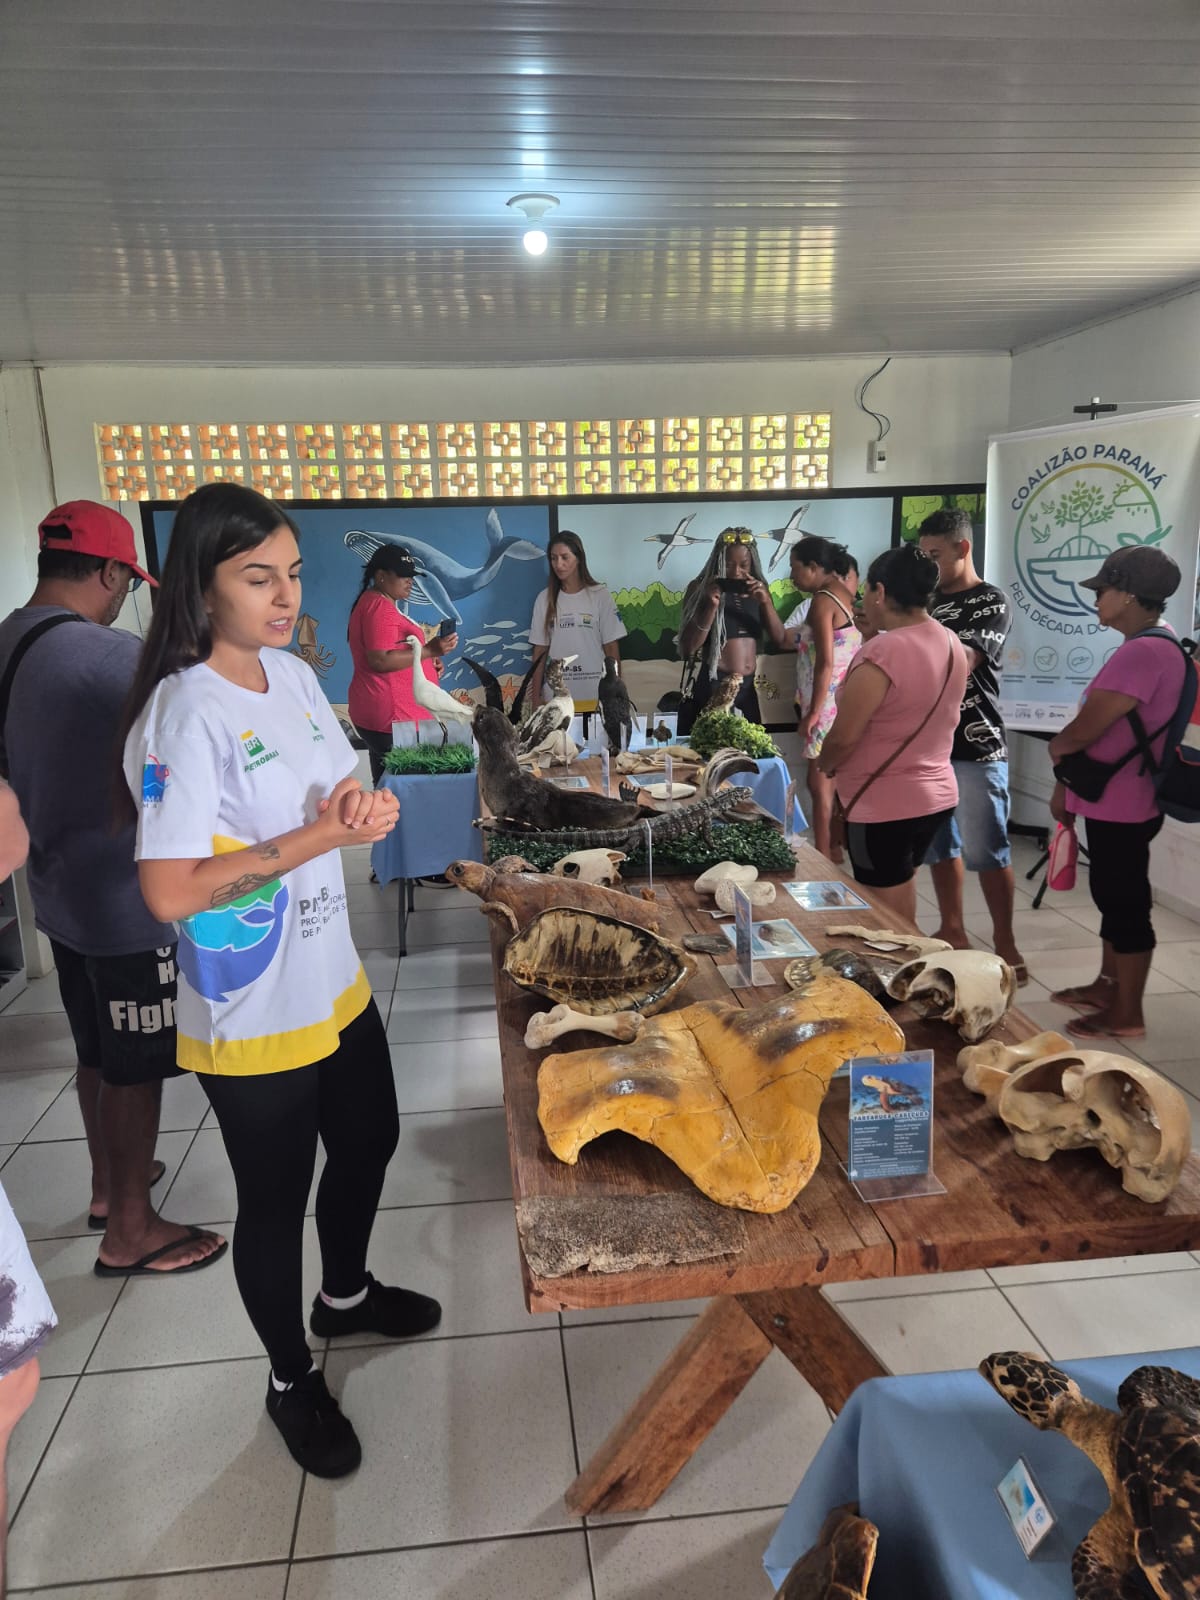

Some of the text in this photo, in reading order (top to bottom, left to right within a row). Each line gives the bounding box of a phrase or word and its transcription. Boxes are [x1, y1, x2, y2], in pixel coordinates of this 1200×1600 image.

[1011, 444, 1168, 511] COALIZÃO PARANÁ
[1010, 582, 1031, 614] PELA
[1030, 609, 1084, 635] DÉCADA
[109, 998, 178, 1034] Figh
